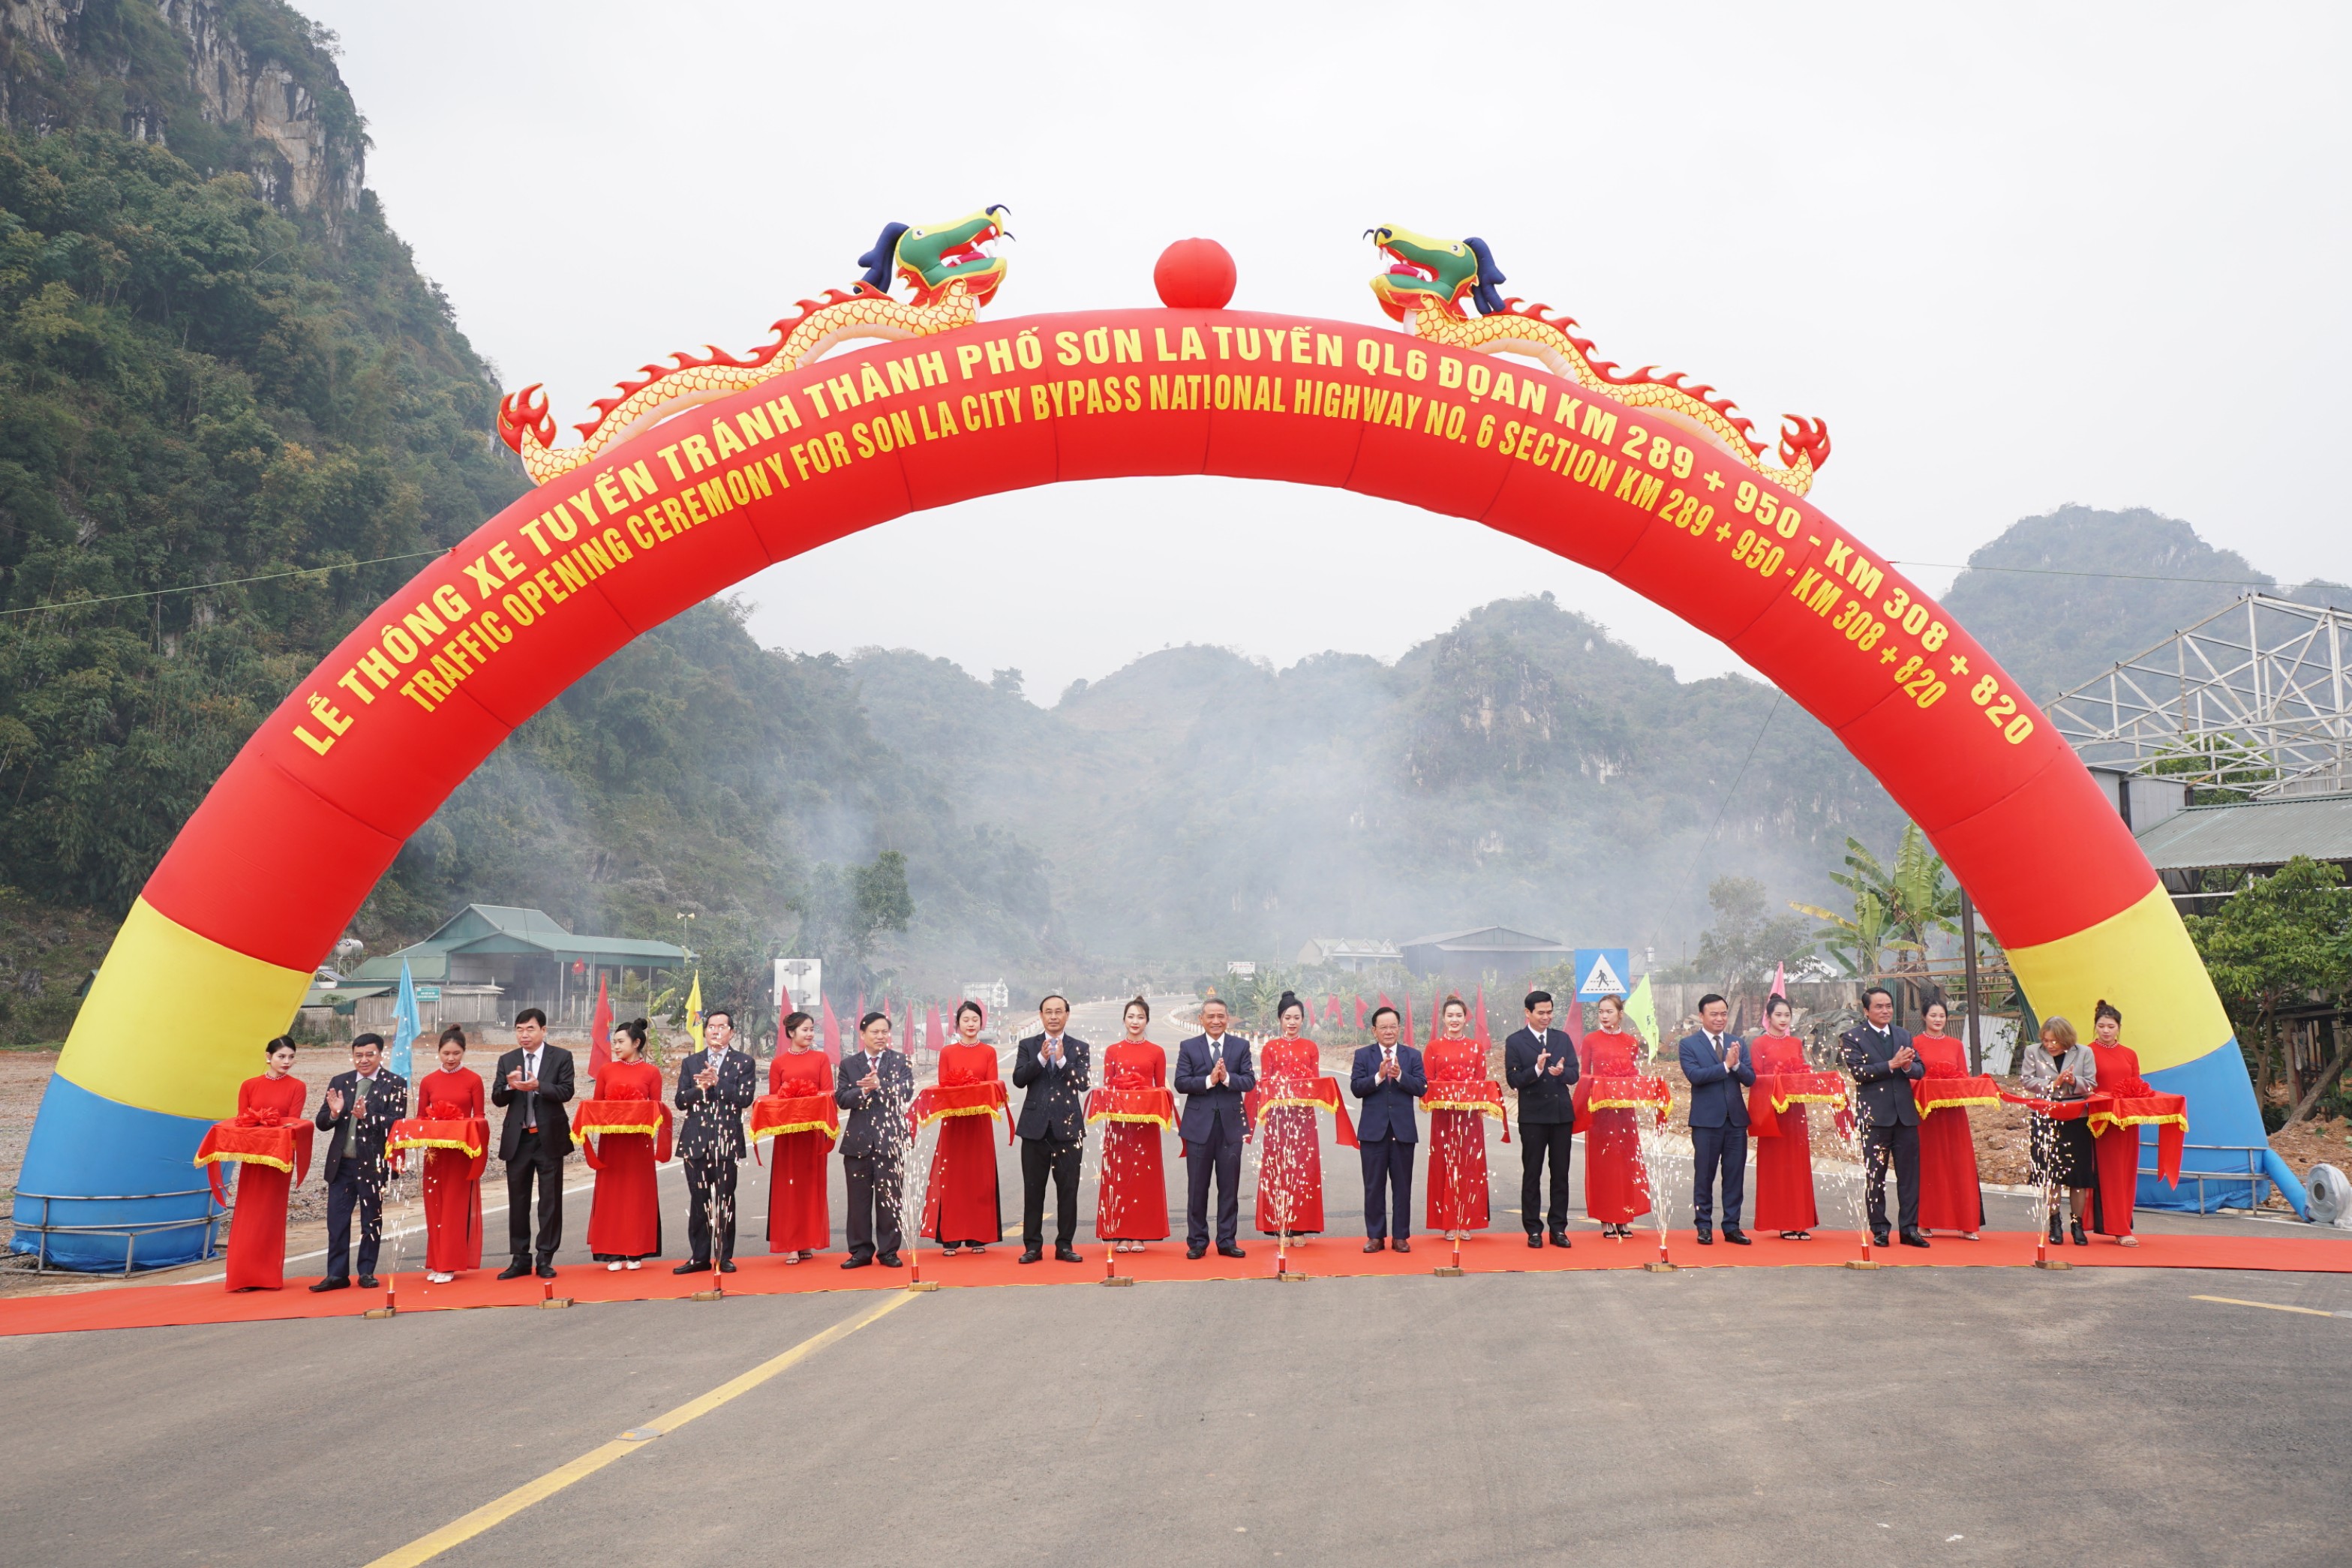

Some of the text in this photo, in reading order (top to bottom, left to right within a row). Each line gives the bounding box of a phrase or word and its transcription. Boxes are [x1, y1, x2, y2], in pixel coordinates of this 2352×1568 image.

[292, 692, 355, 757] LỄ
[336, 583, 473, 705] THÔNG
[461, 539, 528, 600] XE
[518, 459, 659, 557] TUYẾN
[656, 395, 803, 482] TRÁNH
[802, 350, 950, 419] THÀNH
[956, 326, 1044, 380] PHỐ
[1055, 326, 1143, 367] SƠN
[1155, 326, 1207, 362] LA
[1212, 325, 1344, 368] TUYẾN
[1356, 338, 1428, 382] QL6
[1554, 392, 1618, 446] KM
[1621, 425, 1695, 479] 289
[1703, 470, 1726, 492] +
[1733, 479, 1802, 539] 950
[1823, 537, 1885, 599] KM
[1882, 587, 1949, 653] 308
[1949, 654, 1970, 676] +
[1970, 674, 2035, 746] 820
[398, 610, 514, 713] TRAFFIC
[501, 527, 634, 627] OPENING
[626, 452, 791, 550] CEREMONY
[789, 430, 853, 482] FOR
[851, 409, 918, 459] SON
[917, 400, 960, 441] LA
[960, 386, 1023, 432] CITY
[1029, 374, 1142, 422] BYPASS
[1149, 373, 1287, 413] NATIONAL
[1293, 378, 1423, 431] HIGHWAY
[1423, 398, 1468, 444] NO.
[1476, 413, 1497, 449] 6
[1497, 419, 1618, 493] SECTION
[1613, 464, 1666, 512] KM
[1657, 488, 1716, 537] 289
[1714, 521, 1733, 543] +
[1730, 528, 1786, 578] 950
[1790, 566, 1844, 618] KM
[1831, 599, 1887, 652] 308
[1879, 645, 1899, 665] +
[1893, 654, 1948, 709] 820
